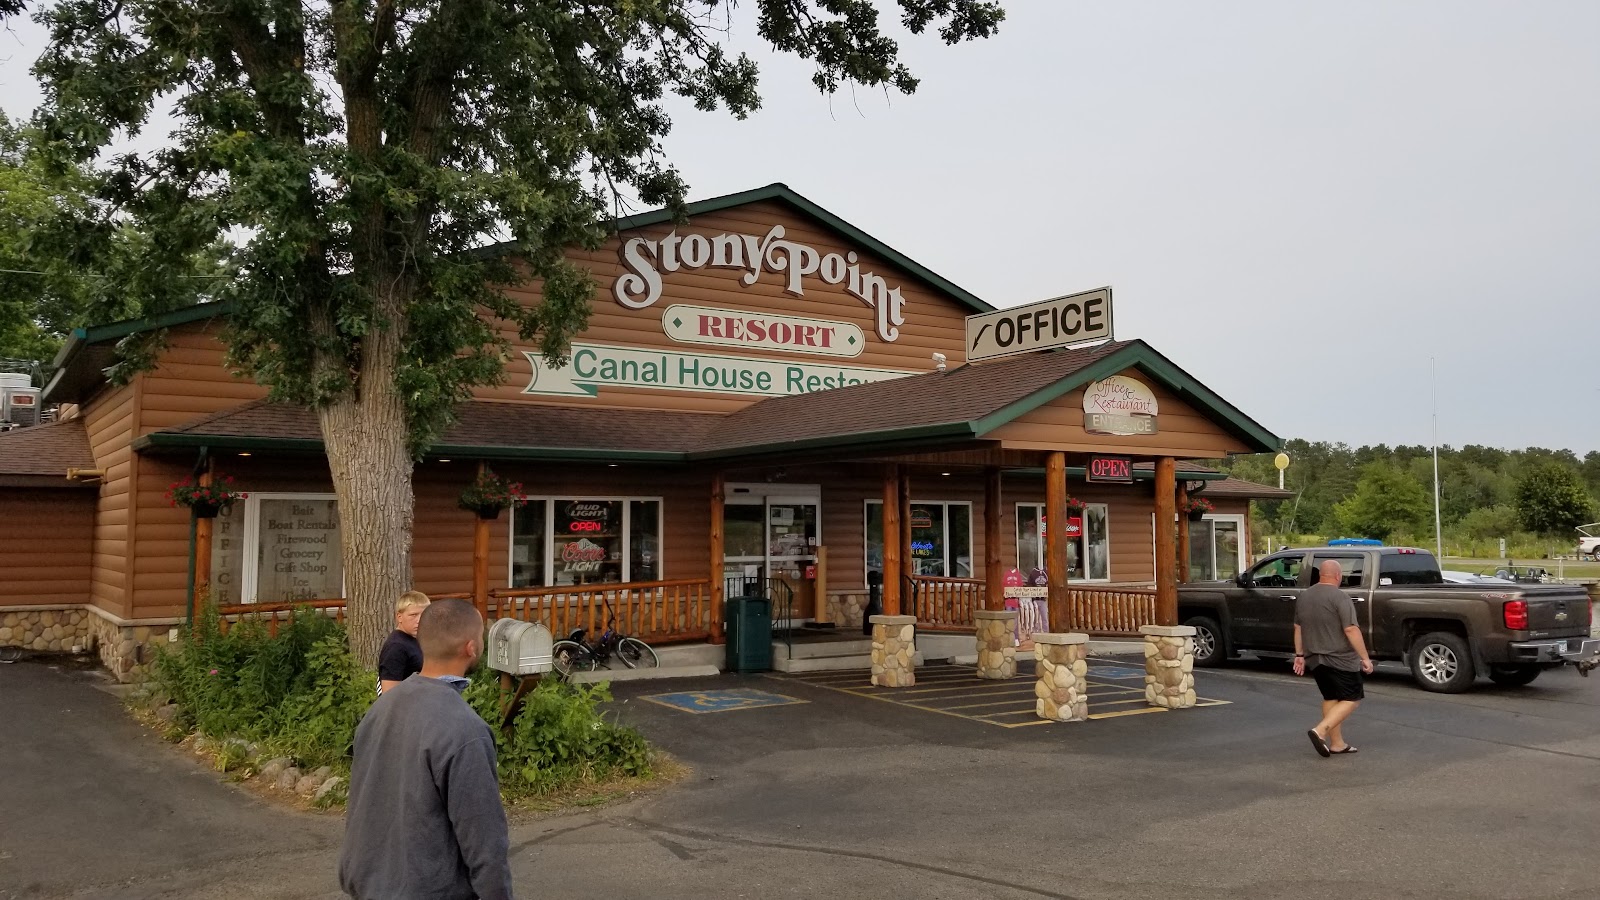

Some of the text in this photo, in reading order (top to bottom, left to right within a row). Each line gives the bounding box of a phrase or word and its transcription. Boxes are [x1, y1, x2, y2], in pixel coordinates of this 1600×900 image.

[613, 224, 906, 343] Stony Point
[995, 298, 1104, 347] OFFICE
[697, 313, 836, 349] RESORT
[573, 349, 877, 393] Canal House Rest
[1090, 393, 1153, 413] Restaurant
[1091, 459, 1130, 477] OPEN
[292, 504, 315, 516] Bait
[267, 519, 337, 530] Boat Rentals
[570, 521, 601, 531] OPEN
[277, 533, 328, 544] Firewood
[280, 547, 324, 561] Grocery
[562, 541, 607, 562] Coors
[274, 562, 328, 575] Gift Shop
[563, 561, 604, 573] LIGHT
[292, 576, 309, 587] Ice
